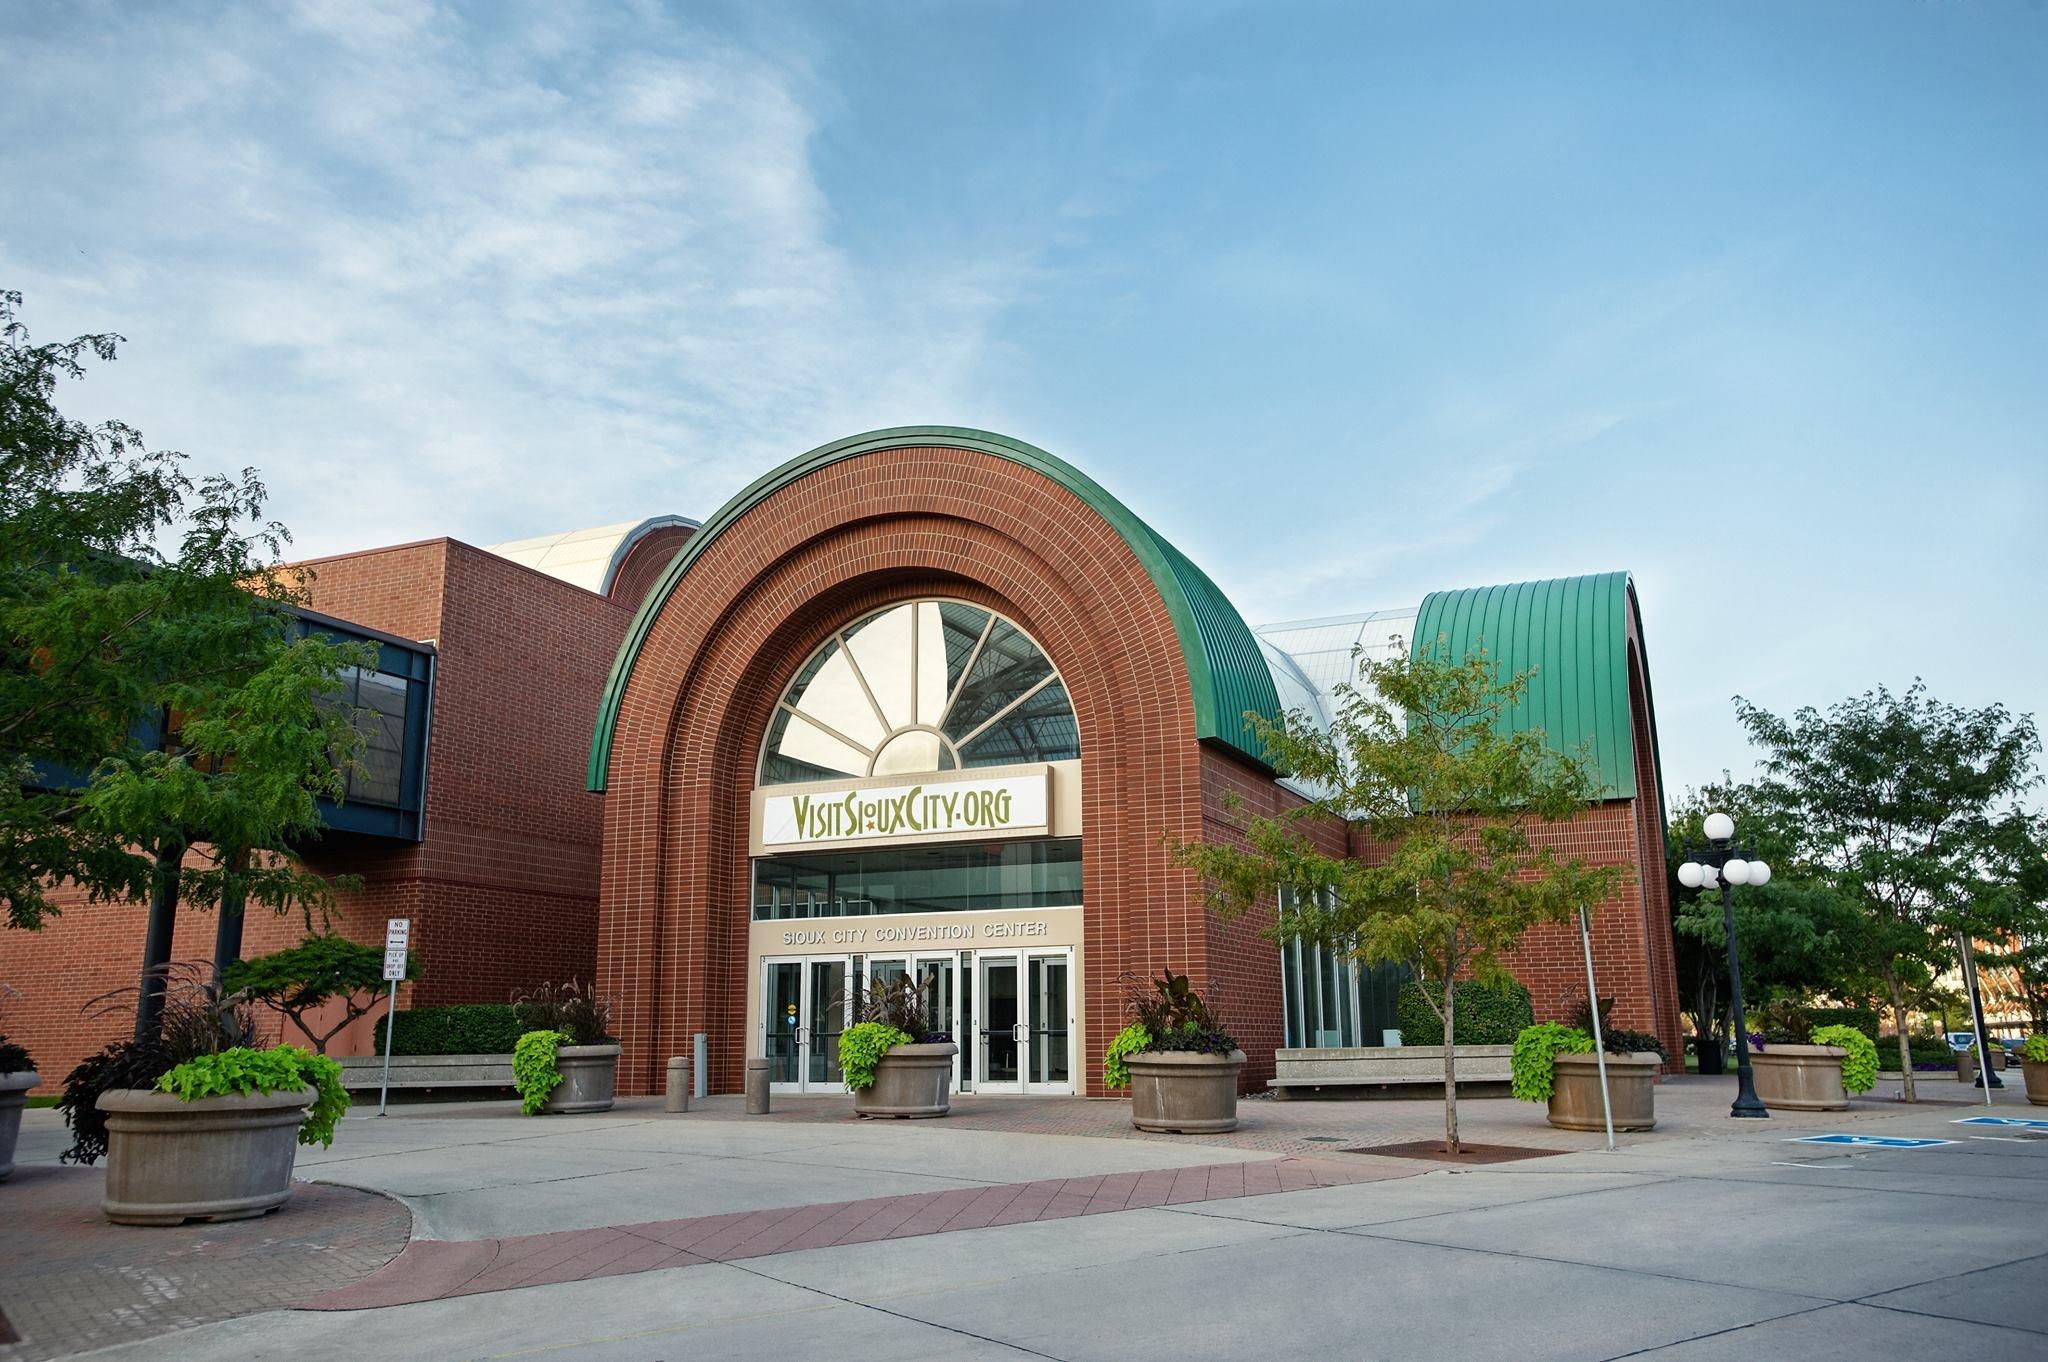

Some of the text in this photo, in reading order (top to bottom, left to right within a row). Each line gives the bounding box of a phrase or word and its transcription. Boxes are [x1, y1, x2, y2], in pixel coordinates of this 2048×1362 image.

[783, 921, 1047, 945] SIOUX CITY CONVENTION CENTER
